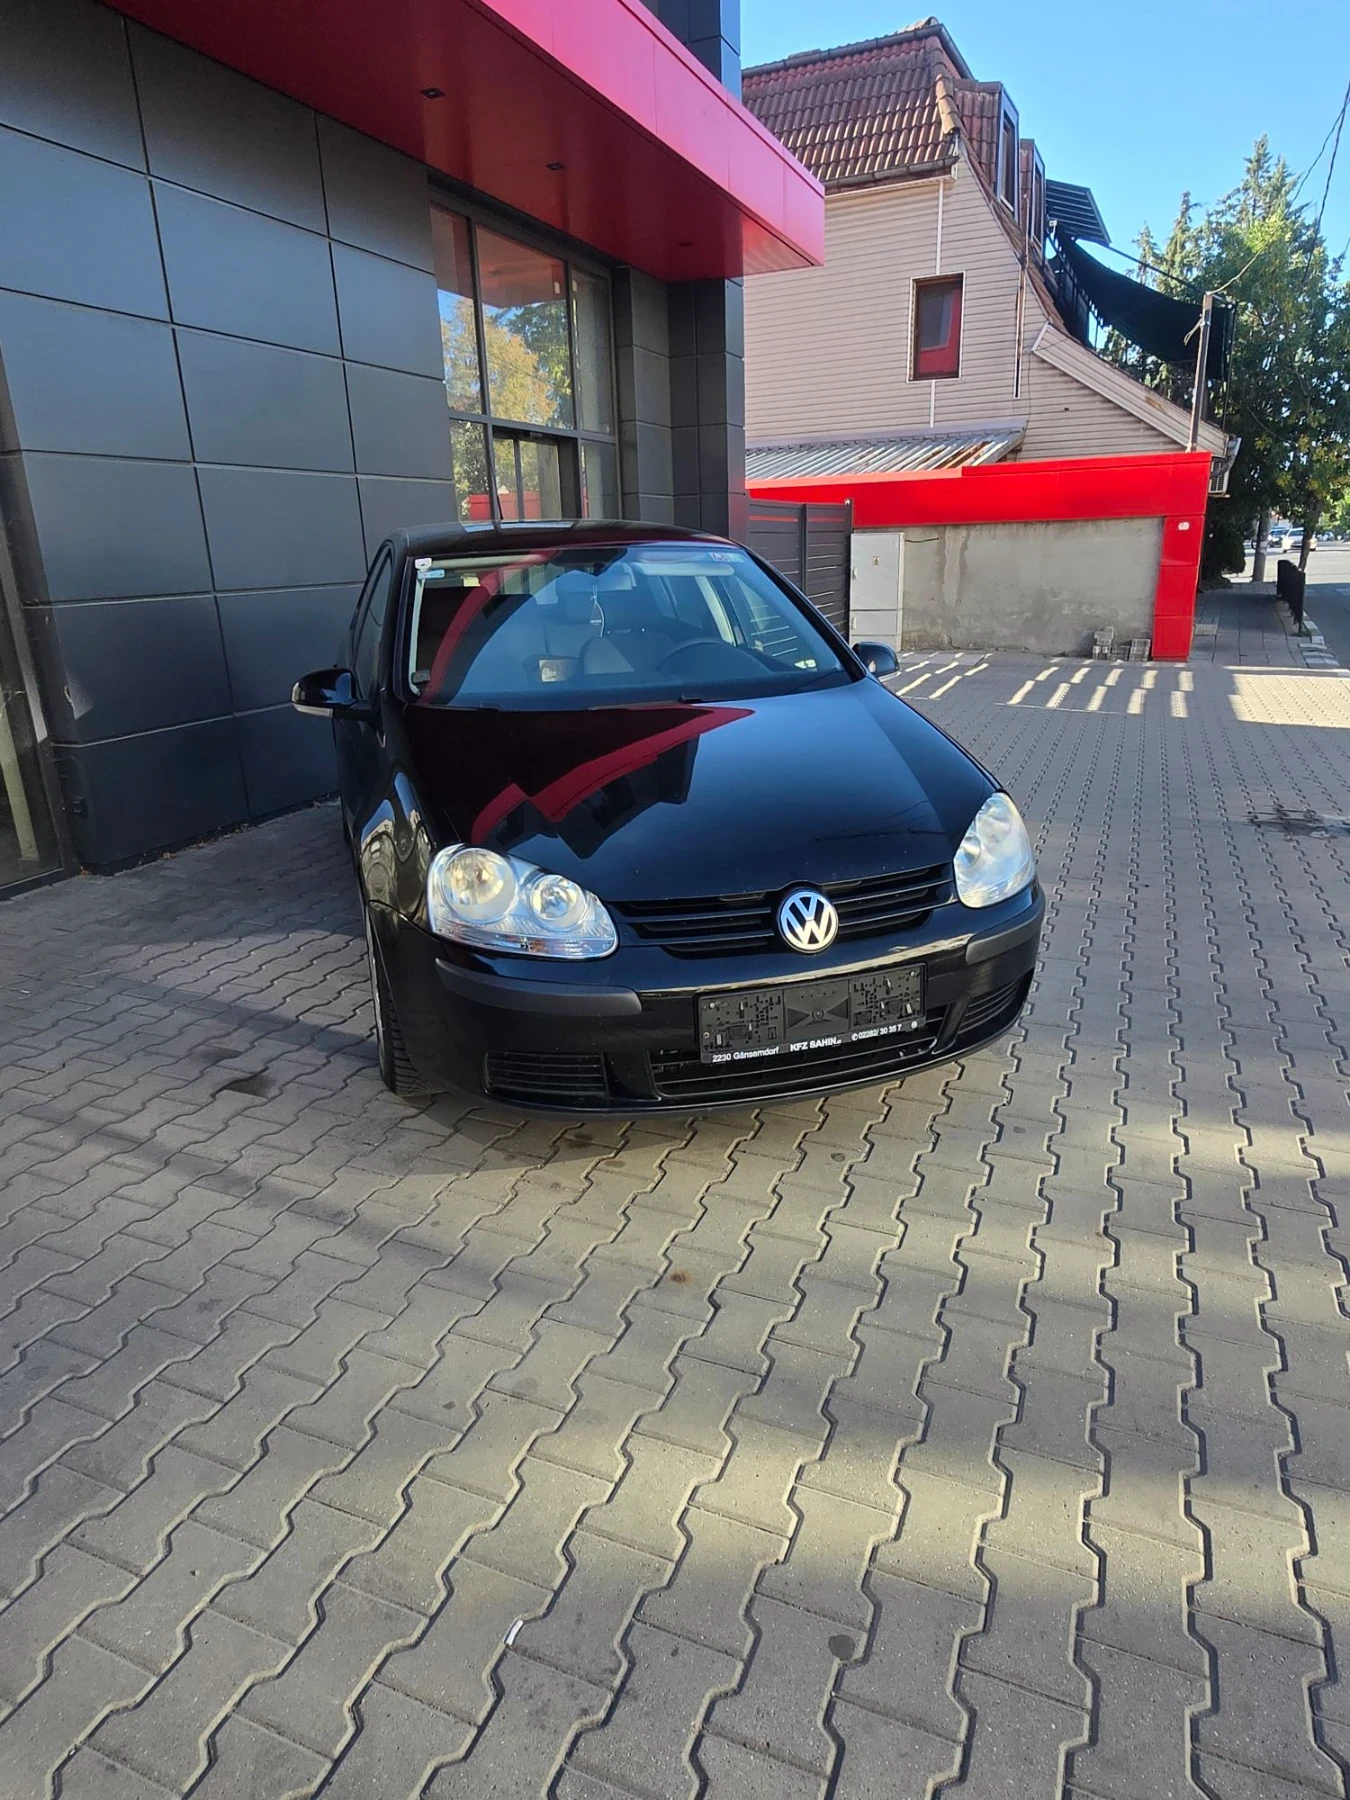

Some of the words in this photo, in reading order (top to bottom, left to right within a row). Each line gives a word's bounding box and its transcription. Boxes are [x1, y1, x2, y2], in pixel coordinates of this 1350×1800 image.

[780, 891, 837, 950] VW
[712, 1053, 732, 1063] 2230
[790, 1041, 808, 1052] KFZ
